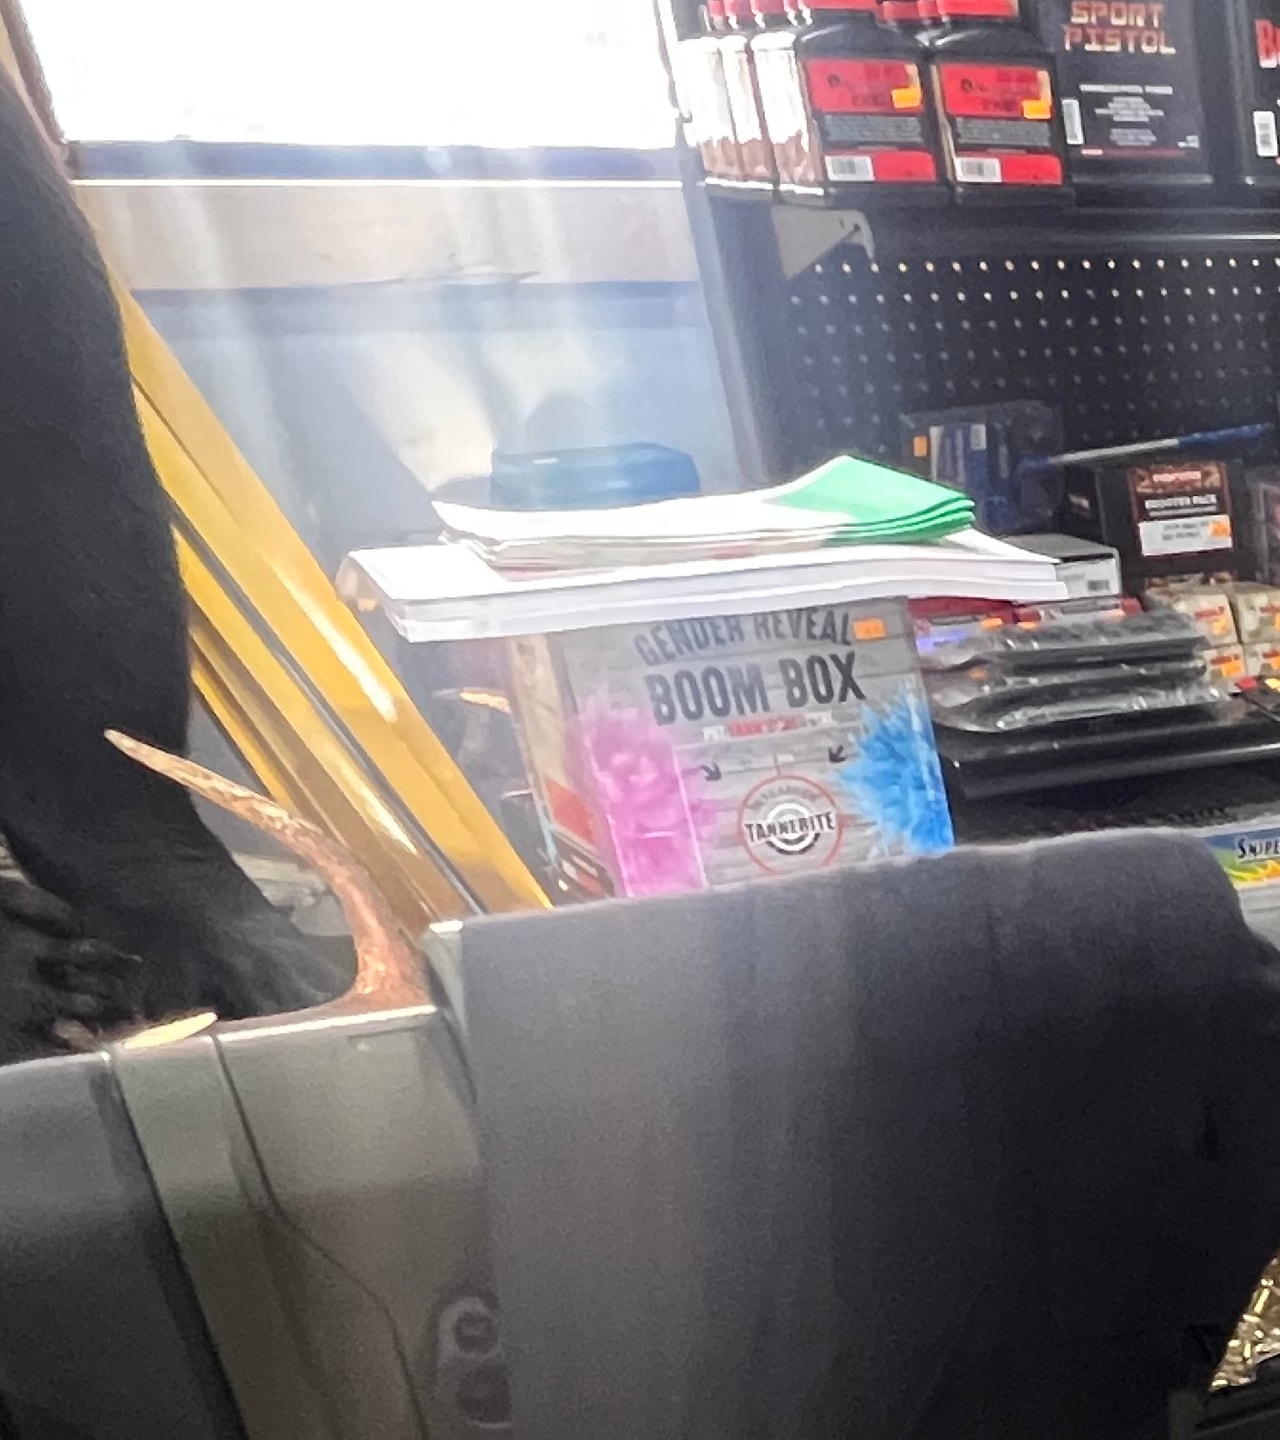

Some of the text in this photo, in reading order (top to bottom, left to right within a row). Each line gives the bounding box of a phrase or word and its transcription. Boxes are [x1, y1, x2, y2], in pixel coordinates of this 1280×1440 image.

[1071, 0, 1164, 27] SPORT
[1062, 25, 1177, 54] PISTOL
[633, 607, 851, 666] GENDER REVEAL
[644, 663, 771, 727] BOOM
[778, 651, 867, 708] BOX
[743, 811, 835, 843] TANNERITE
